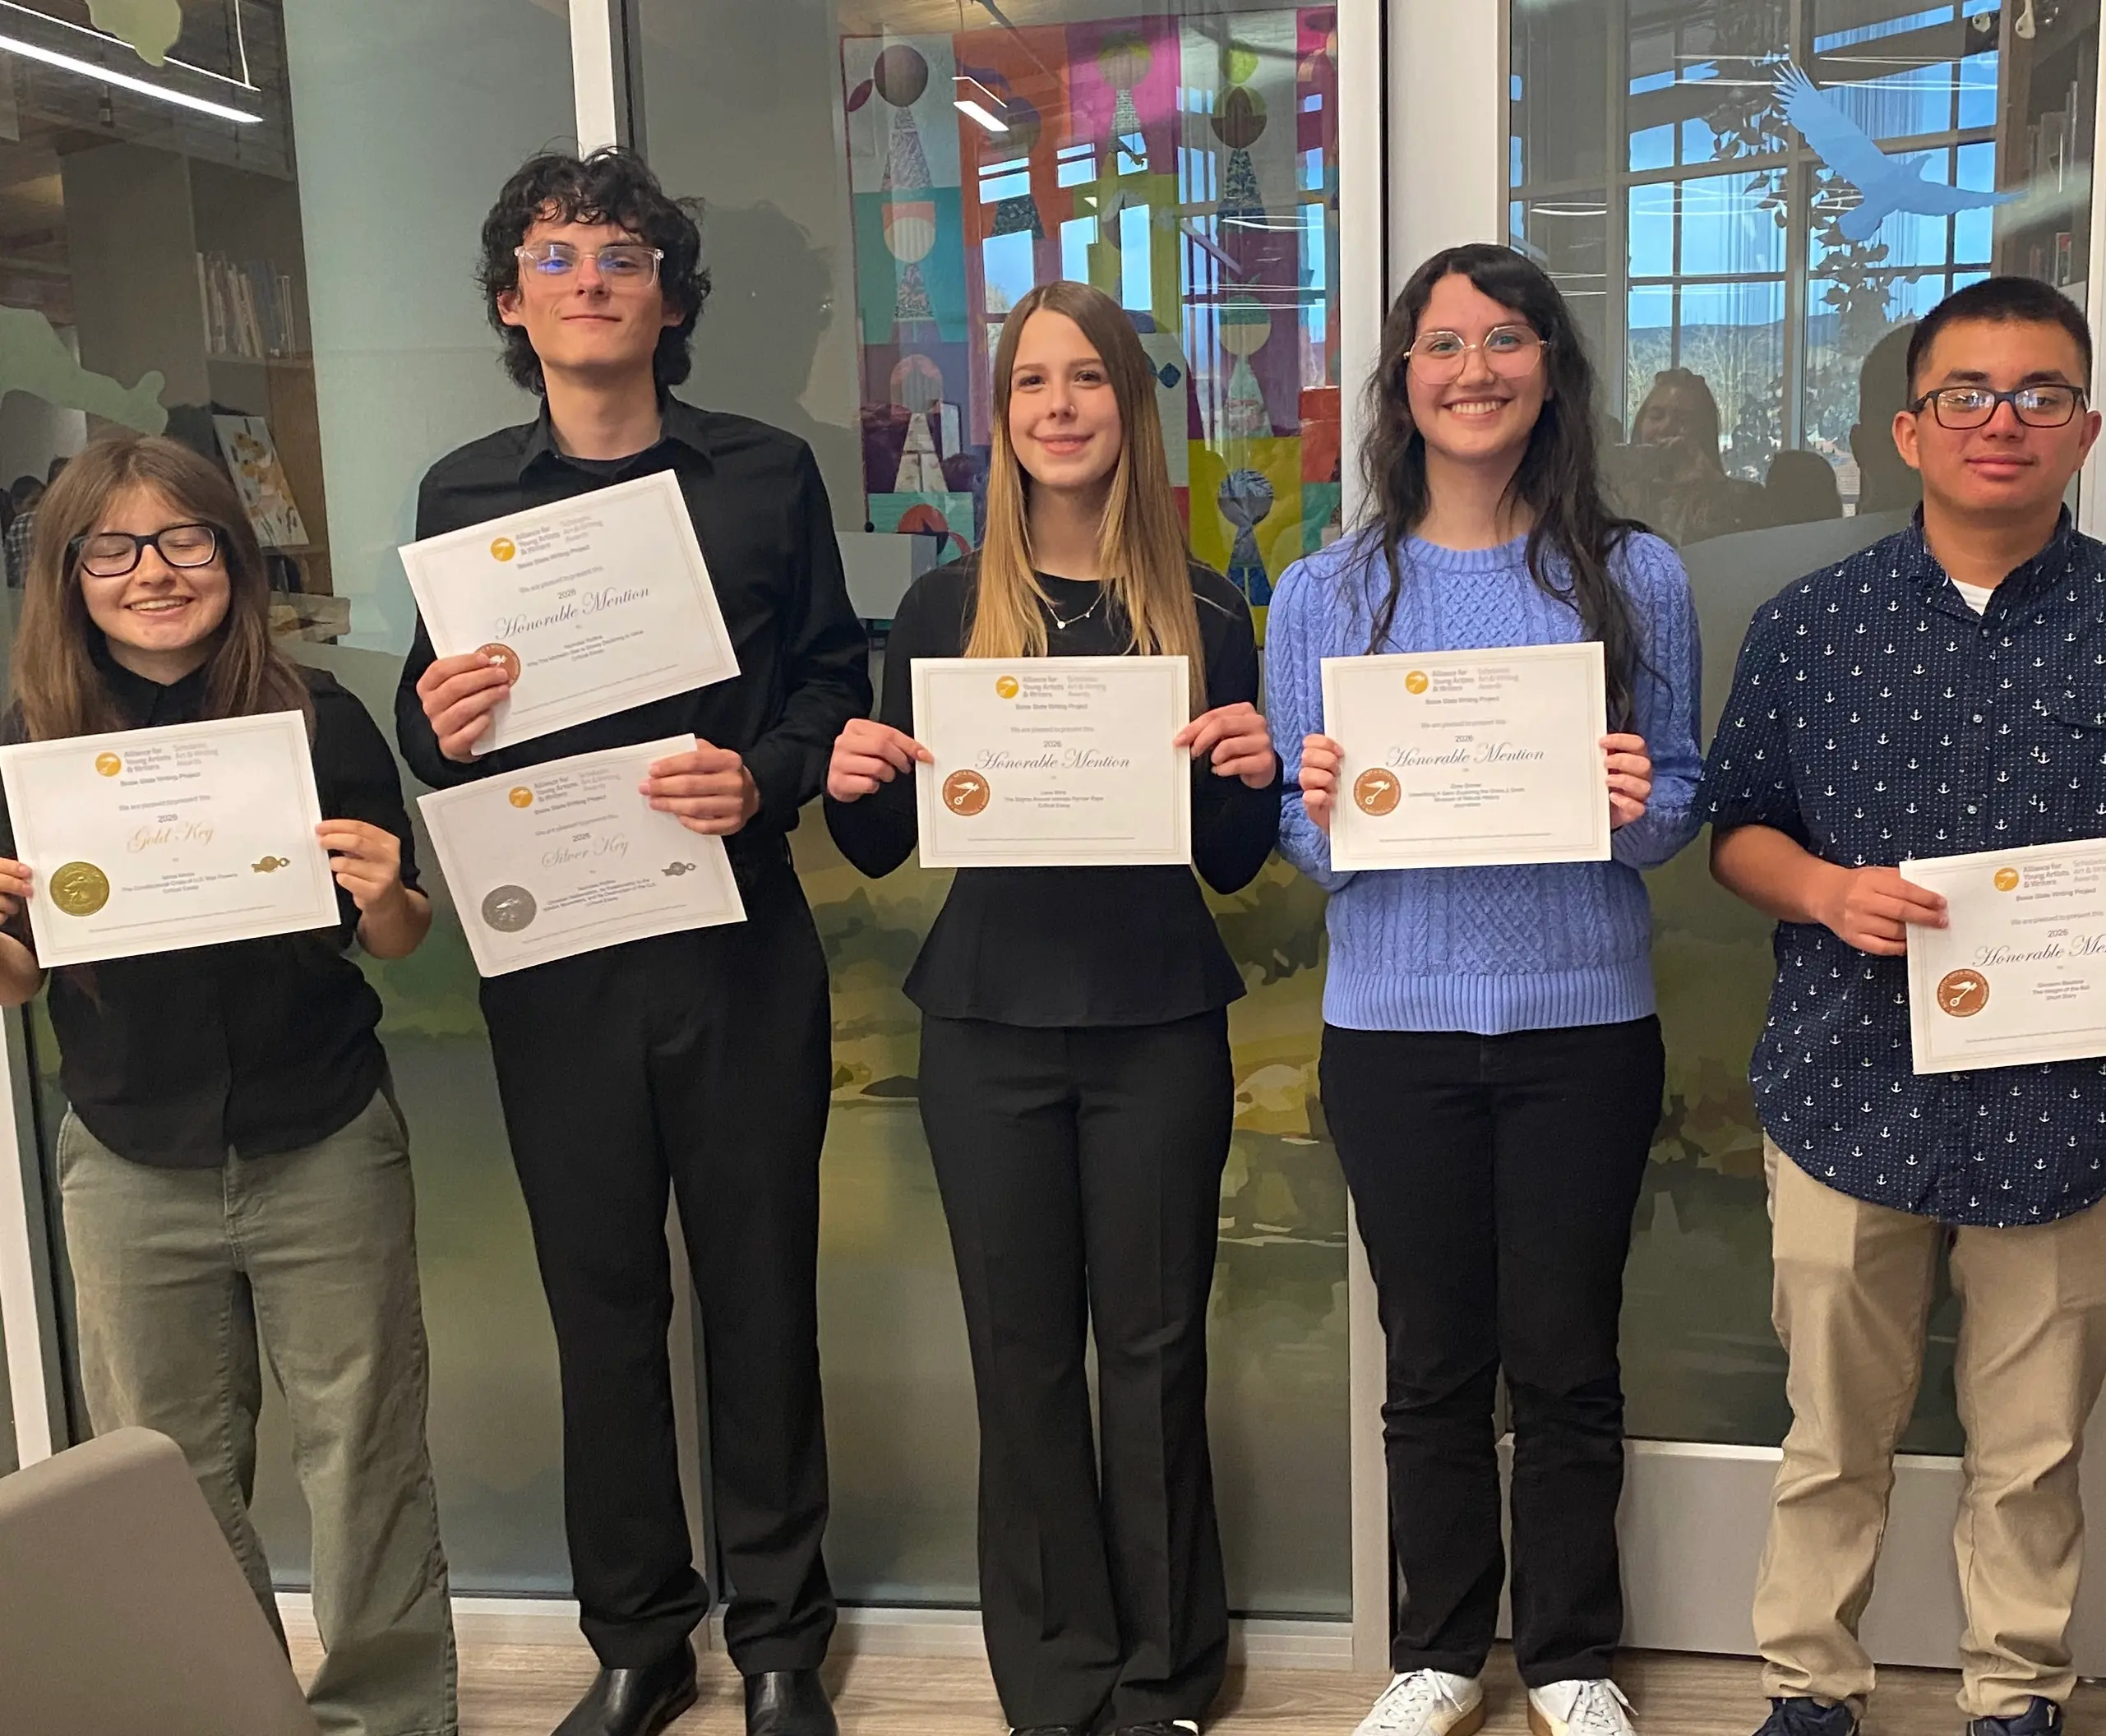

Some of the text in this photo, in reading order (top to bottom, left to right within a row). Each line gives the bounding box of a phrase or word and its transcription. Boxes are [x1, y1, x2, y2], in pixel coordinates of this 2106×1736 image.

[495, 586, 650, 640] Honorable Mention
[975, 748, 1130, 770] Honorable Mention
[1385, 741, 1545, 768] Honorable Mention
[127, 820, 214, 853] Gold Key
[542, 833, 629, 870] Silver Key
[1973, 943, 2064, 967] Honorable
